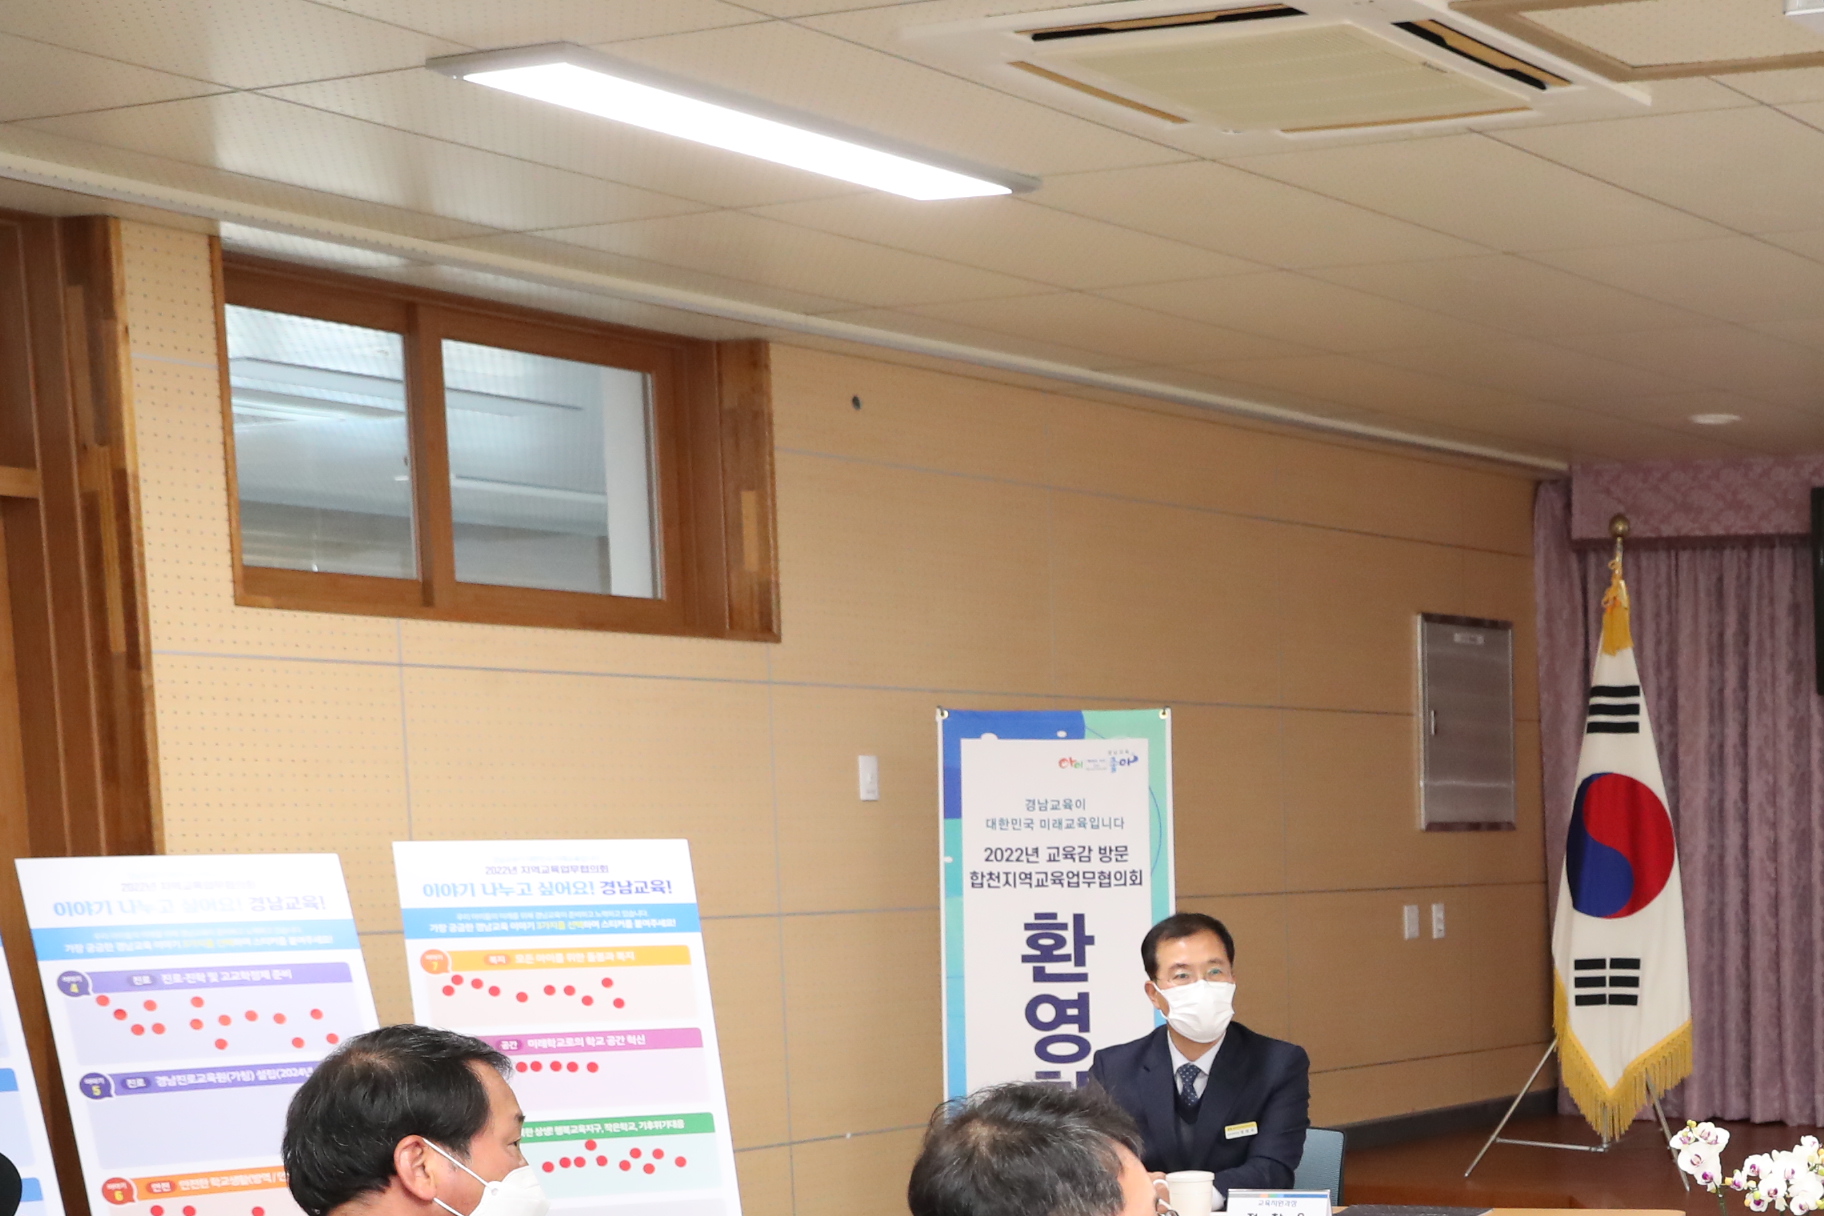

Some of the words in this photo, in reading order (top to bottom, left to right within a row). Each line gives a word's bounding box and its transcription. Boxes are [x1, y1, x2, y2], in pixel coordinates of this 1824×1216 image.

[1025, 799, 1086, 812] 경남교육이
[986, 818, 1035, 831] 대한민국
[1039, 816, 1125, 830] 미래교육입니다
[984, 847, 1040, 863] 2022년
[1046, 846, 1093, 863] 교육감
[1098, 845, 1129, 863] 방문
[485, 866, 518, 876] 2022년
[969, 869, 1143, 889] 합천지역교육업무협의회
[423, 882, 476, 898] 이야기
[482, 881, 533, 896] 나누고
[538, 880, 595, 896] 싶어요!
[600, 879, 673, 895] 경남교육!
[53, 901, 112, 917] 이야기
[119, 899, 175, 915] 나누고
[250, 895, 327, 913] 경남교육!
[133, 975, 152, 985] 진로
[501, 1041, 518, 1050] 공간
[585, 1036, 605, 1047] 학교
[606, 1035, 626, 1046] 공간
[627, 1034, 646, 1046] 혁신
[126, 1078, 146, 1088] 진로
[93, 1086, 101, 1096] 5
[114, 1191, 124, 1201] 6
